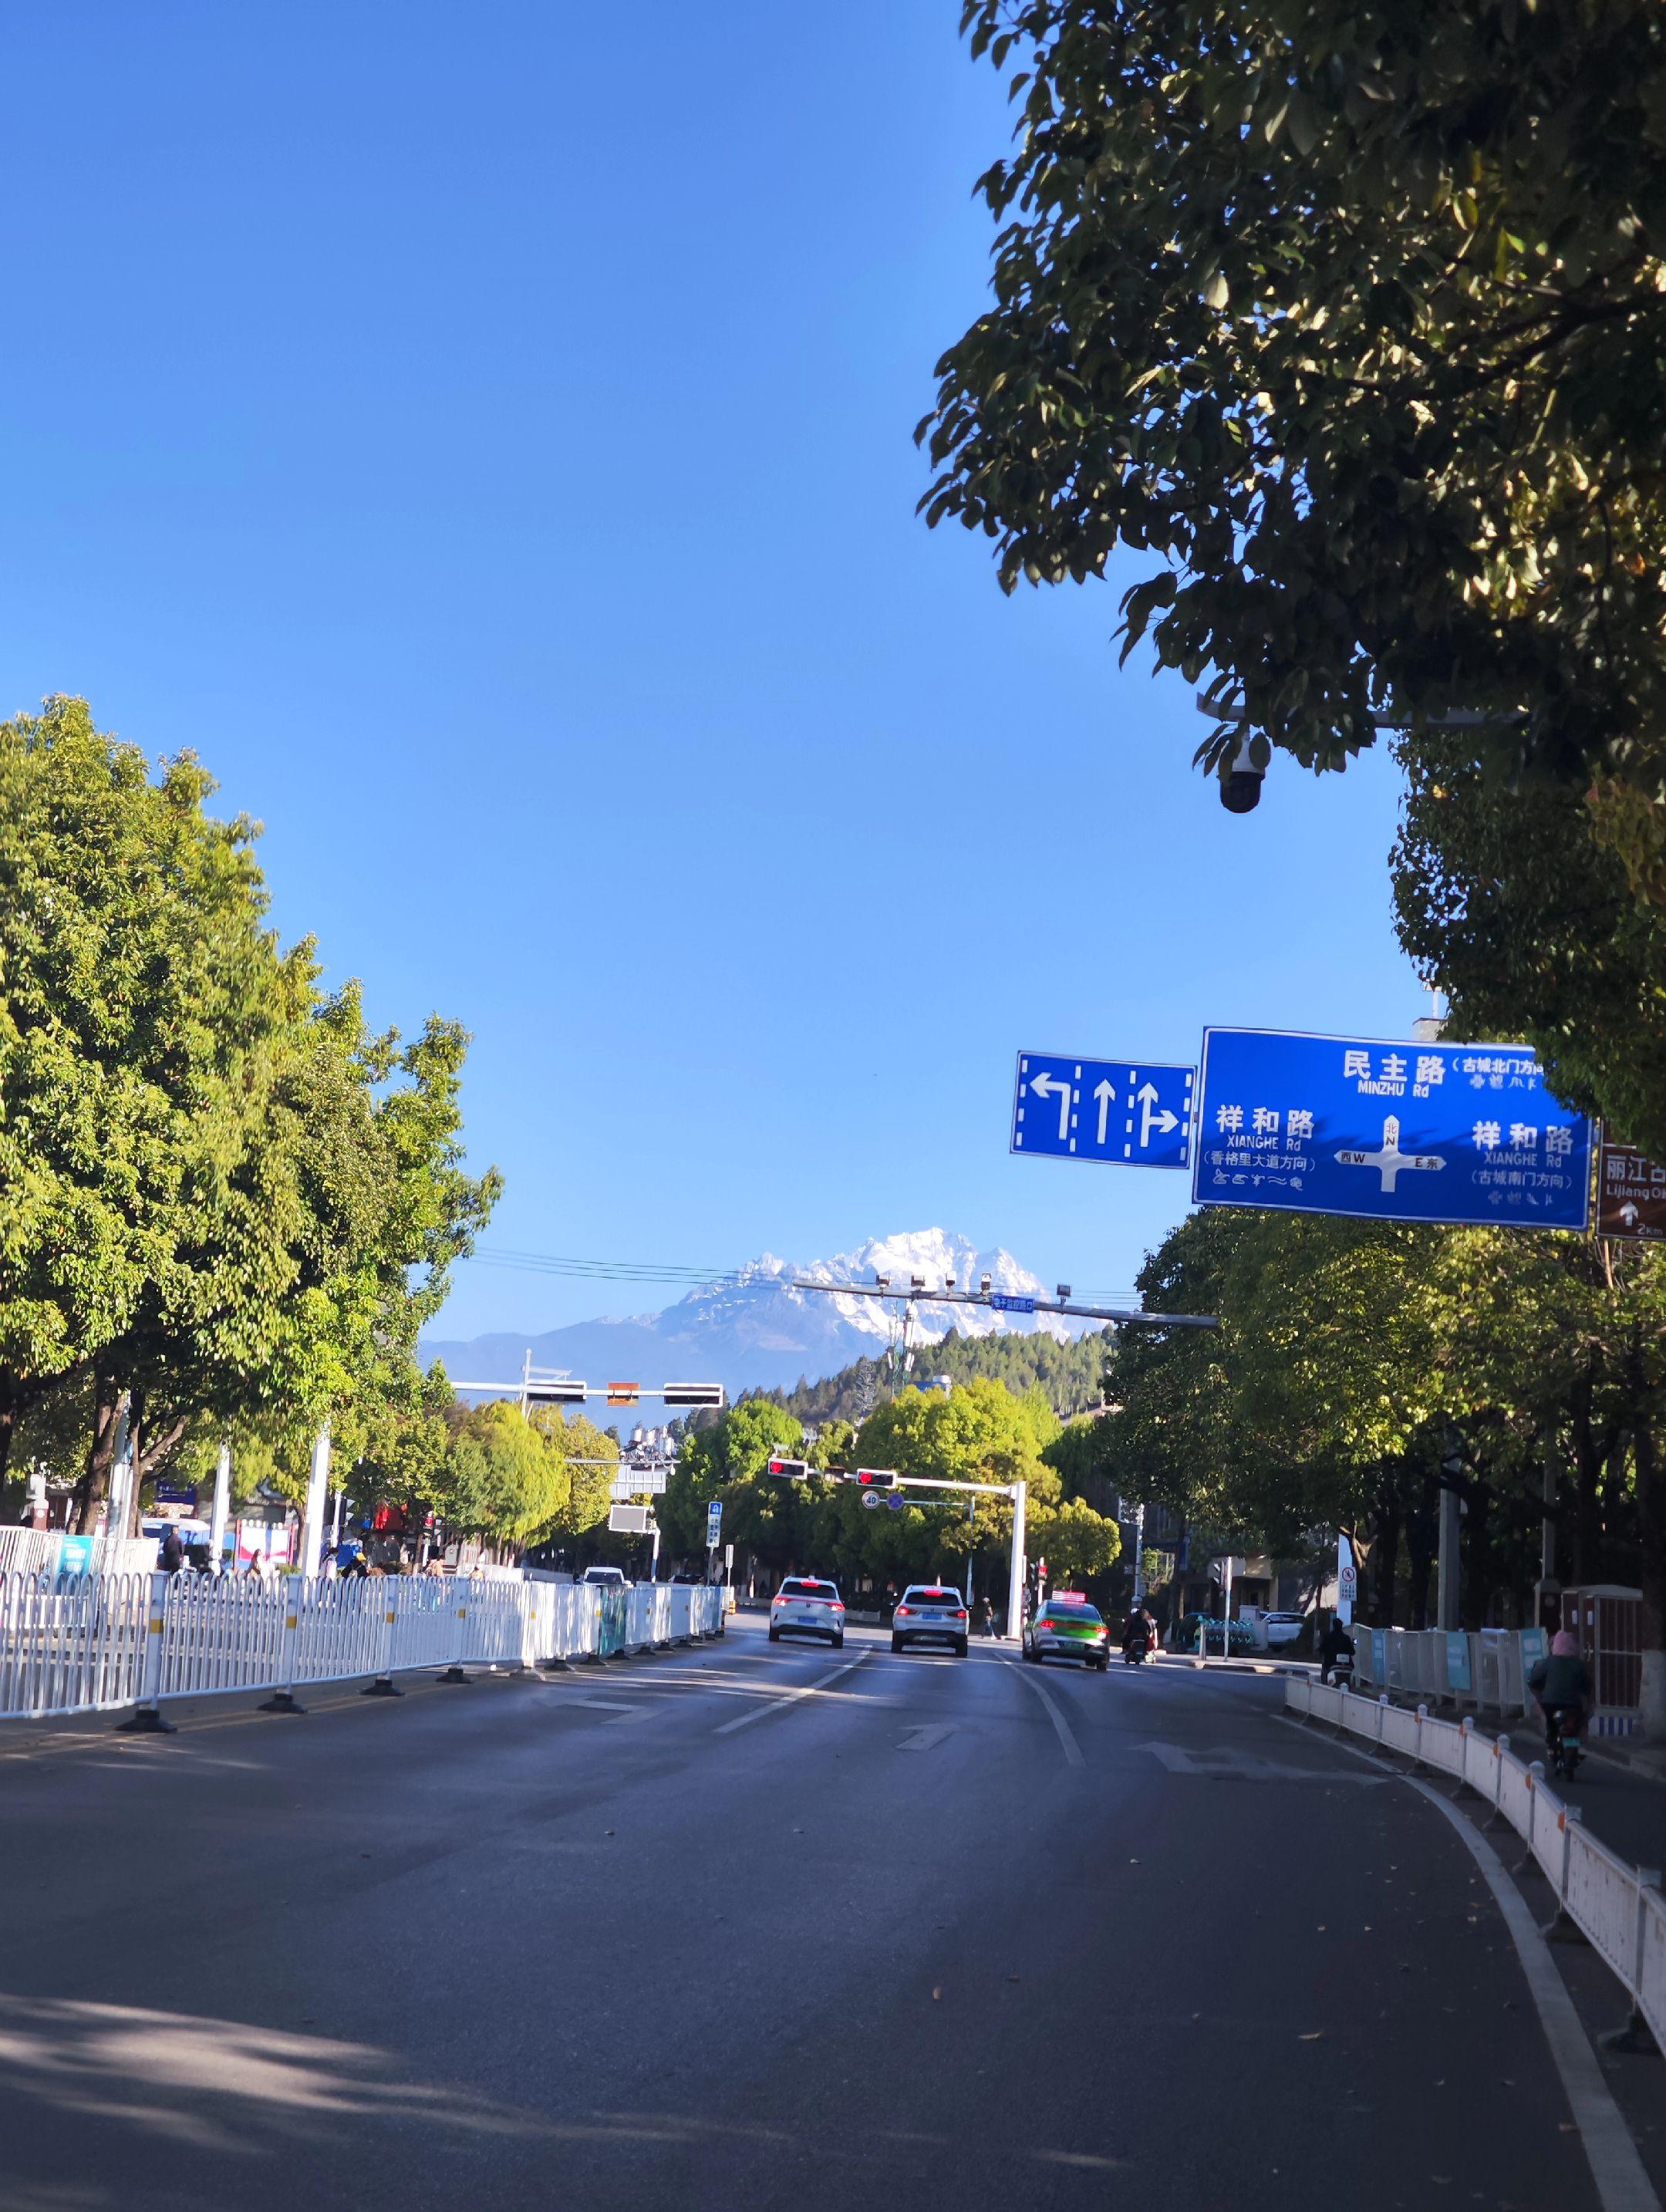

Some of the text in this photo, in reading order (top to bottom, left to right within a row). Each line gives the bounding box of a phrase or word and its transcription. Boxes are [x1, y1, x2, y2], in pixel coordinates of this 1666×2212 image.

[1344, 1050, 1446, 1085] 民主路
[1357, 1080, 1429, 1098] MINZHU Rd
[1216, 1104, 1314, 1139] 祥和路
[1385, 1122, 1398, 1135] 北
[1227, 1135, 1302, 1152] XIANGHE Rd
[1385, 1136, 1395, 1146] N
[1472, 1120, 1574, 1155] 祥和路
[1415, 1157, 1423, 1168] E
[1484, 1151, 1562, 1168] XIANGHE Rd
[866, 1496, 877, 1505] 40
